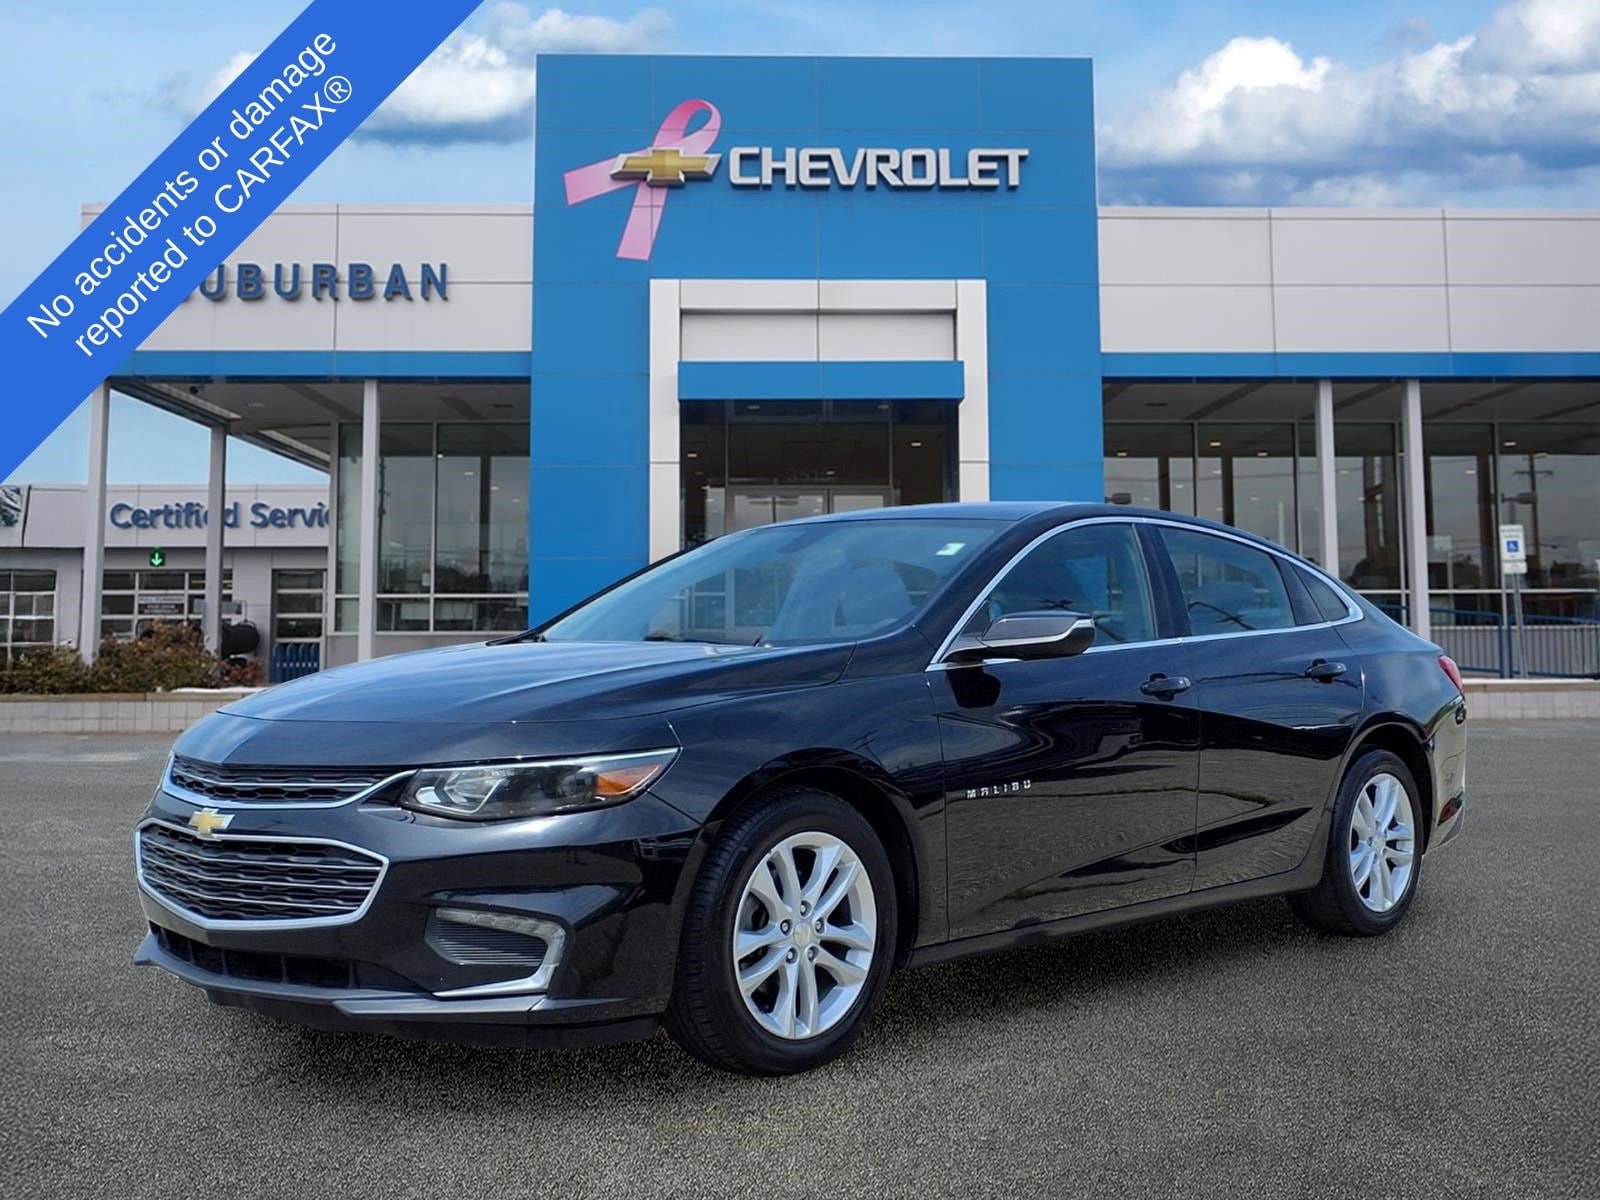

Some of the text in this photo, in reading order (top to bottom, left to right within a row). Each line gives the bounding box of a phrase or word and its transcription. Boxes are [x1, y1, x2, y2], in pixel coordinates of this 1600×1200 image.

[728, 146, 1030, 191] CHEVROLET
[184, 262, 449, 302] UBURBAN
[966, 779, 1032, 799] MALIBU
